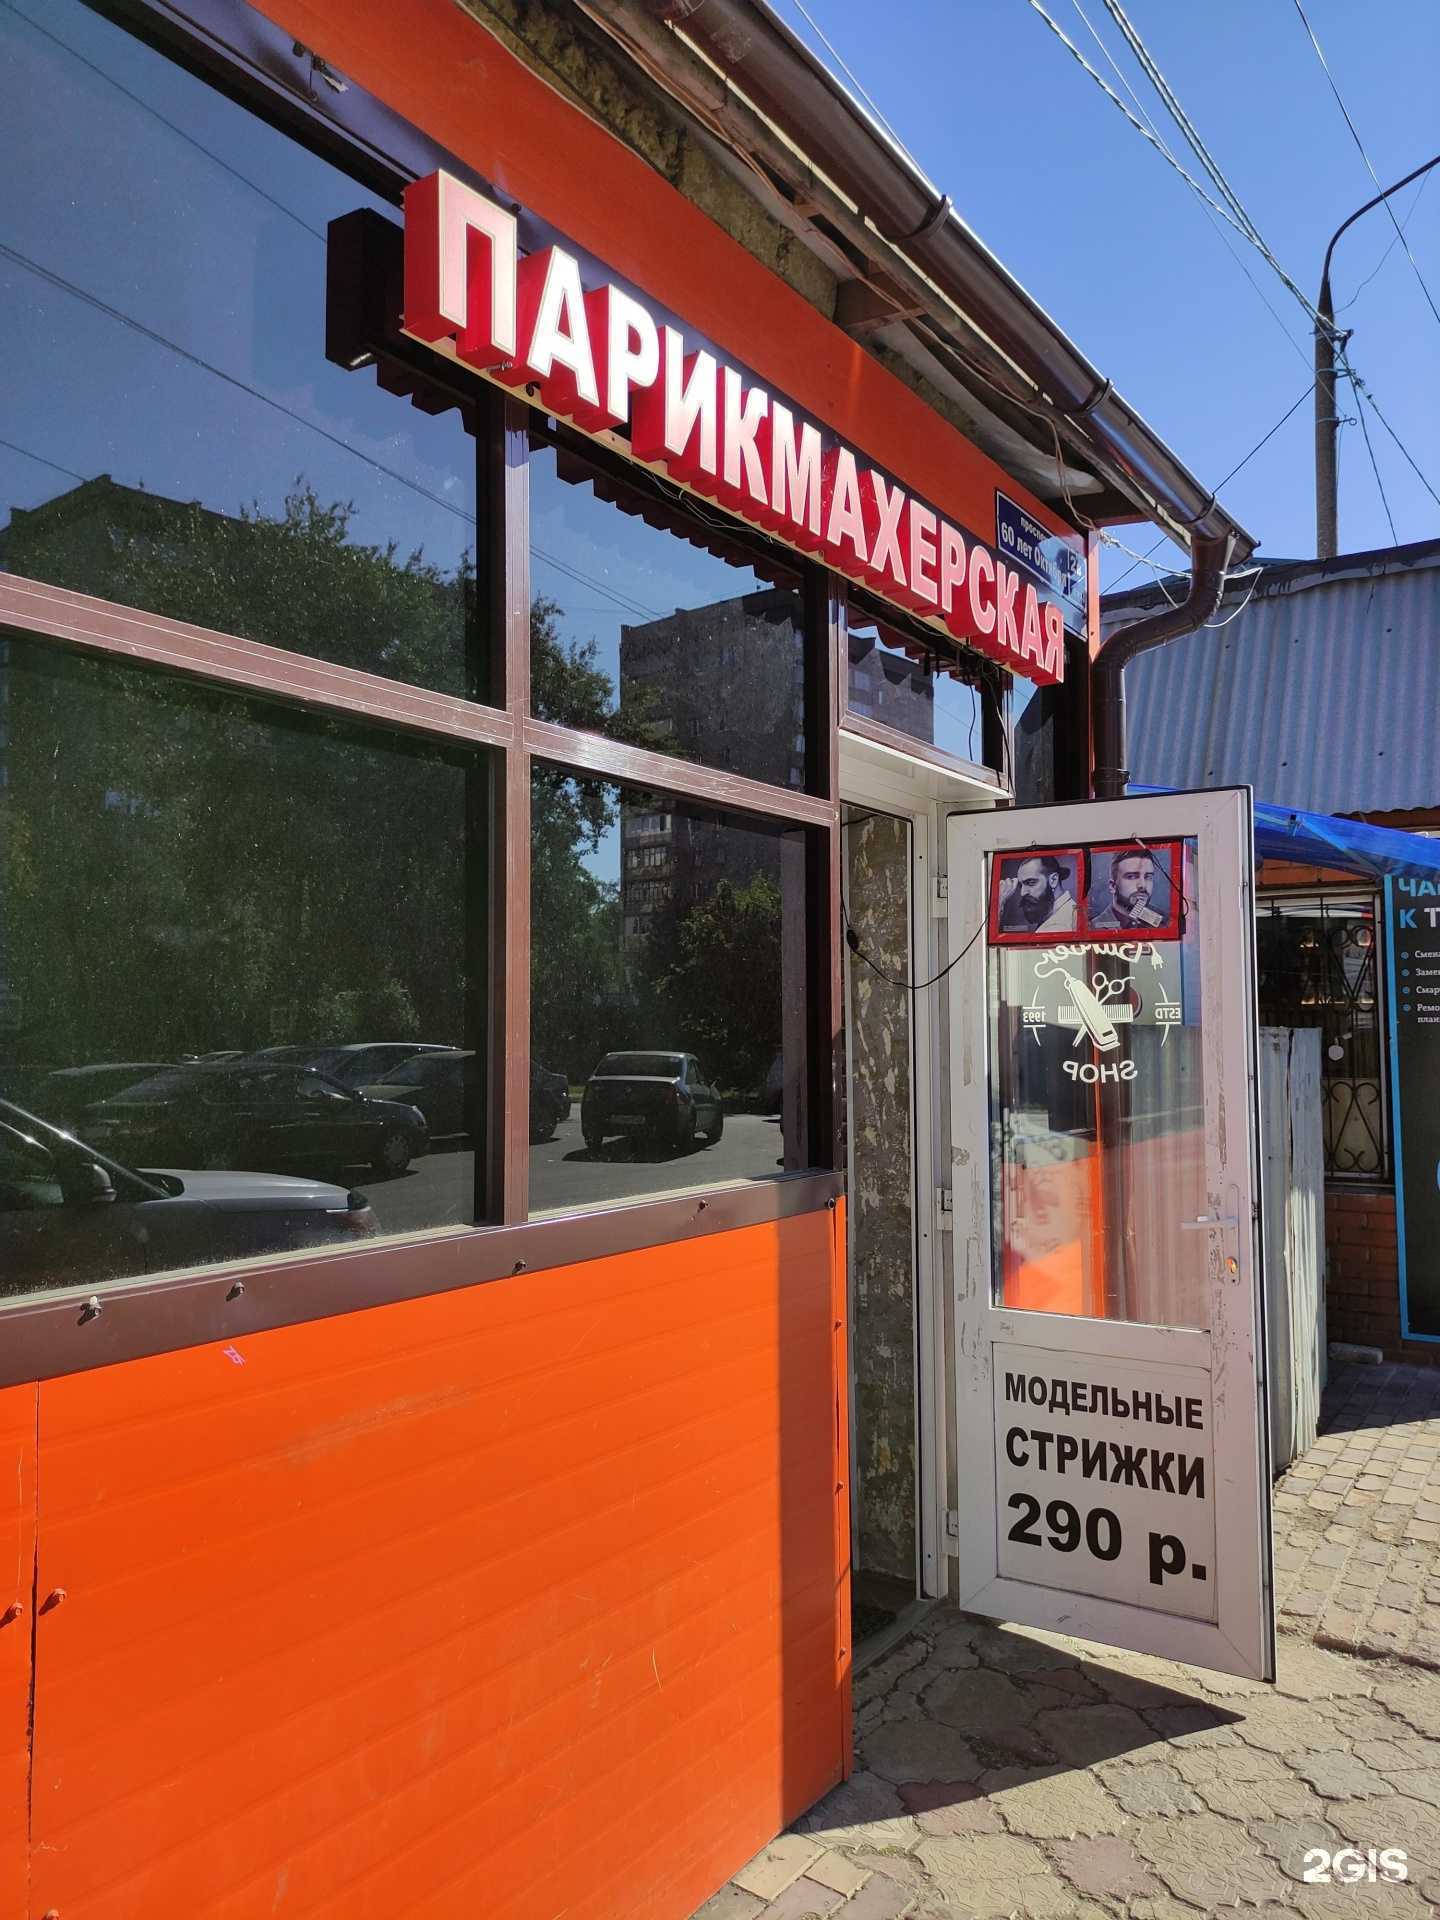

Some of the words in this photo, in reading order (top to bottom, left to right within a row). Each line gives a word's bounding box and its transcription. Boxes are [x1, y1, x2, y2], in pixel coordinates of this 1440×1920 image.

[436, 167, 1066, 684] ПАРИКМАХЕРСКАЯ
[1001, 522, 1014, 547] 60
[1017, 537, 1032, 560] лет
[1398, 878, 1440, 897] ЧА
[1400, 908, 1418, 928] К
[1005, 1372, 1204, 1430] МОДЕЛЬНЫЕ
[1005, 1426, 1205, 1499] СТРИЖКИ
[1007, 1492, 1123, 1562] 290
[1148, 1531, 1207, 1586] р.
